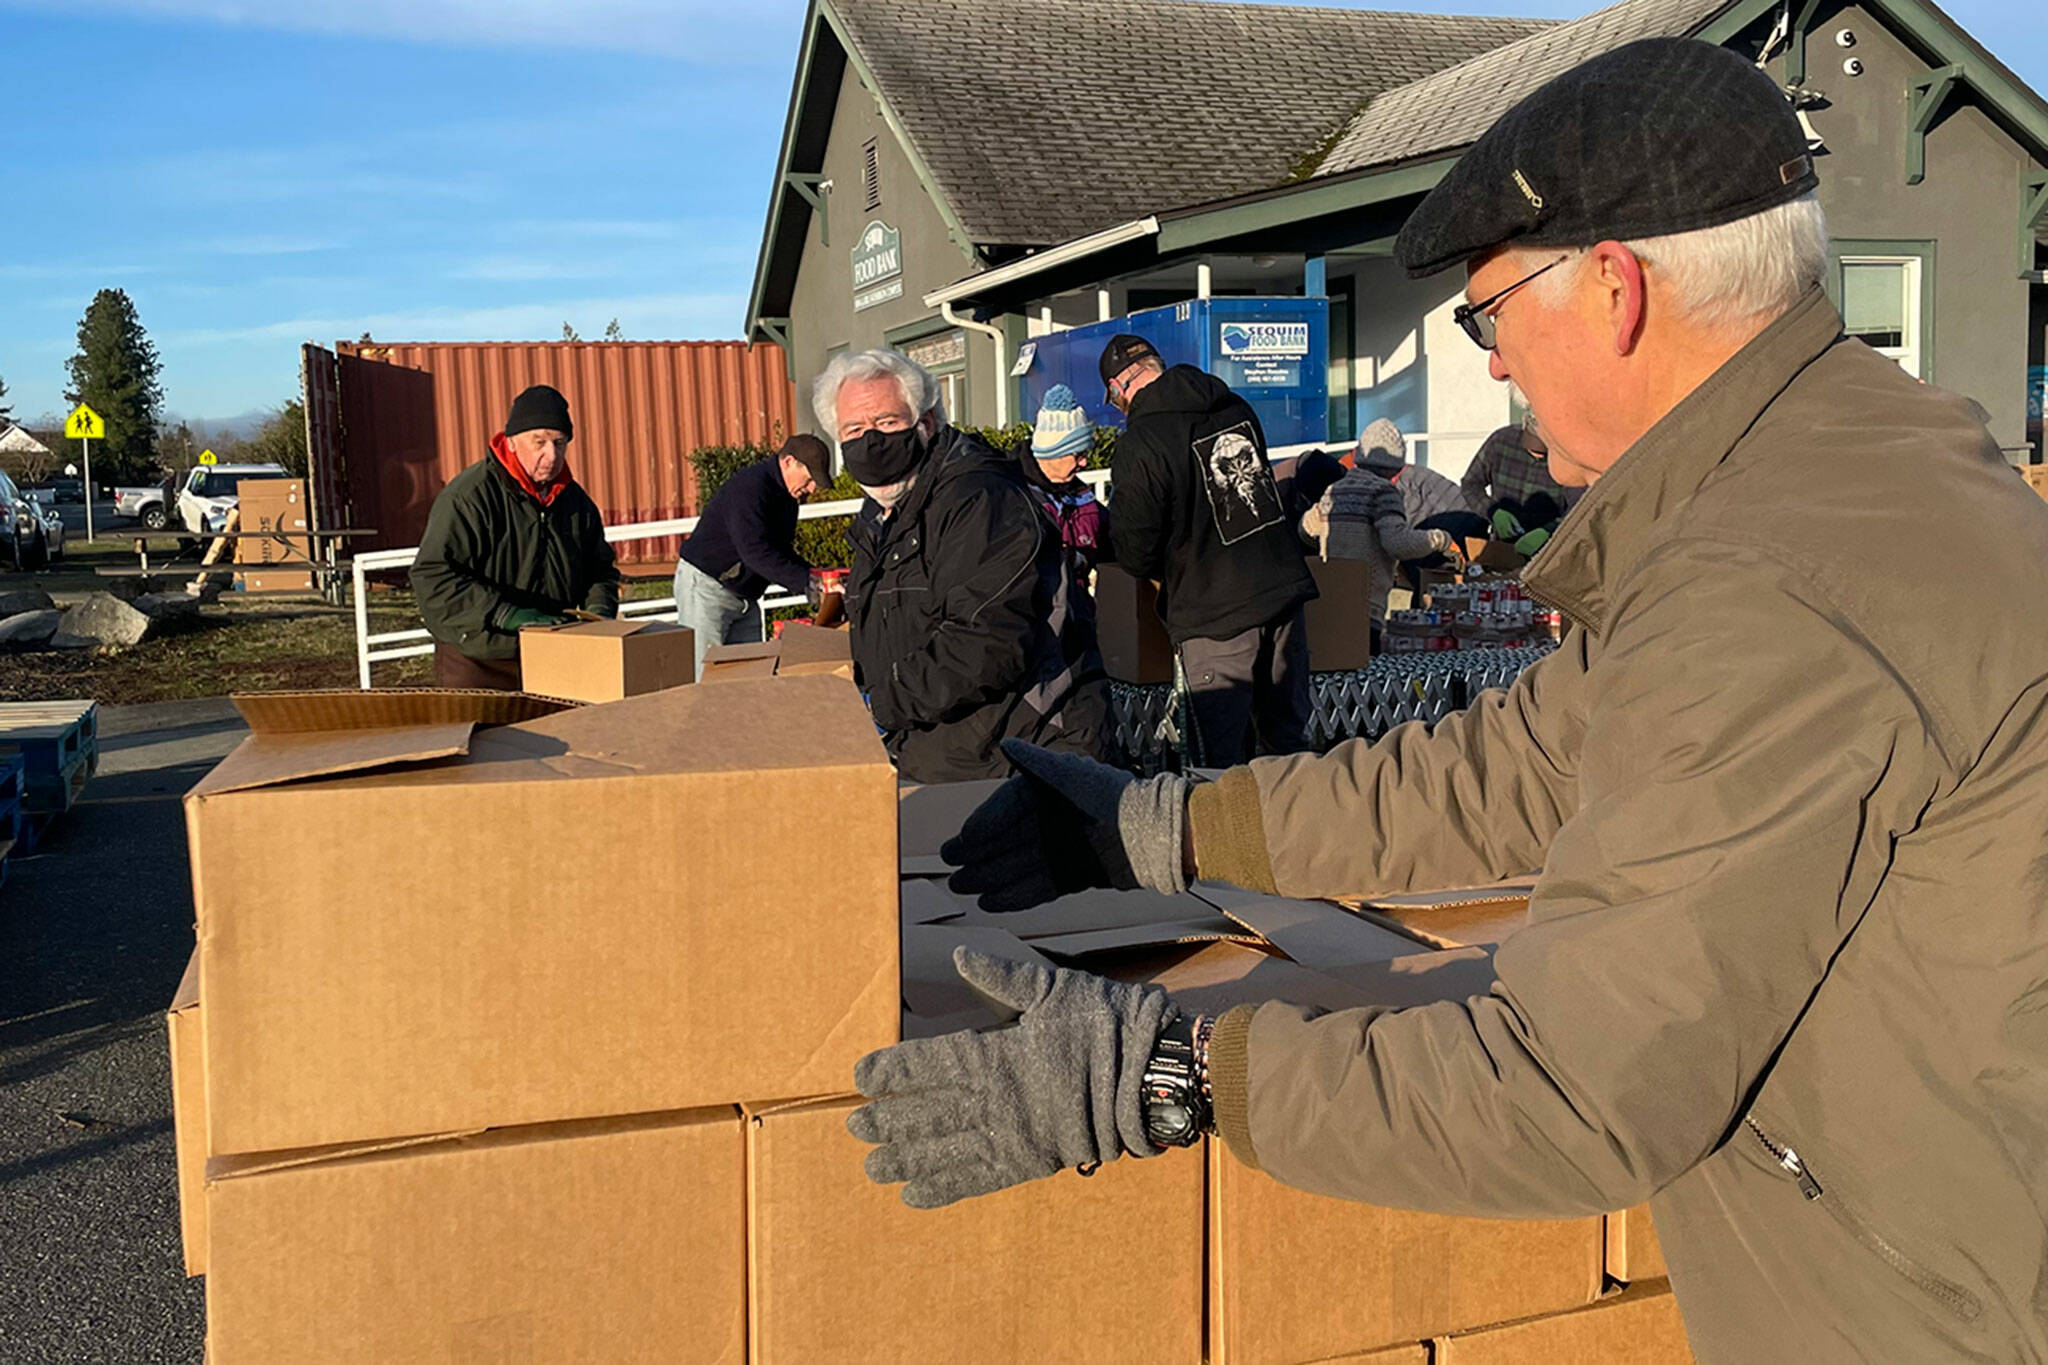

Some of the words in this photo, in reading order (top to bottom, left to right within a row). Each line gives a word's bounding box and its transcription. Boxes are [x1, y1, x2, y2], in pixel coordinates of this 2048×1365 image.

[855, 257, 876, 284] FOOD
[1248, 327, 1305, 336] SEQUIM
[1252, 335, 1278, 346] FOOD
[1280, 335, 1306, 346] BANK
